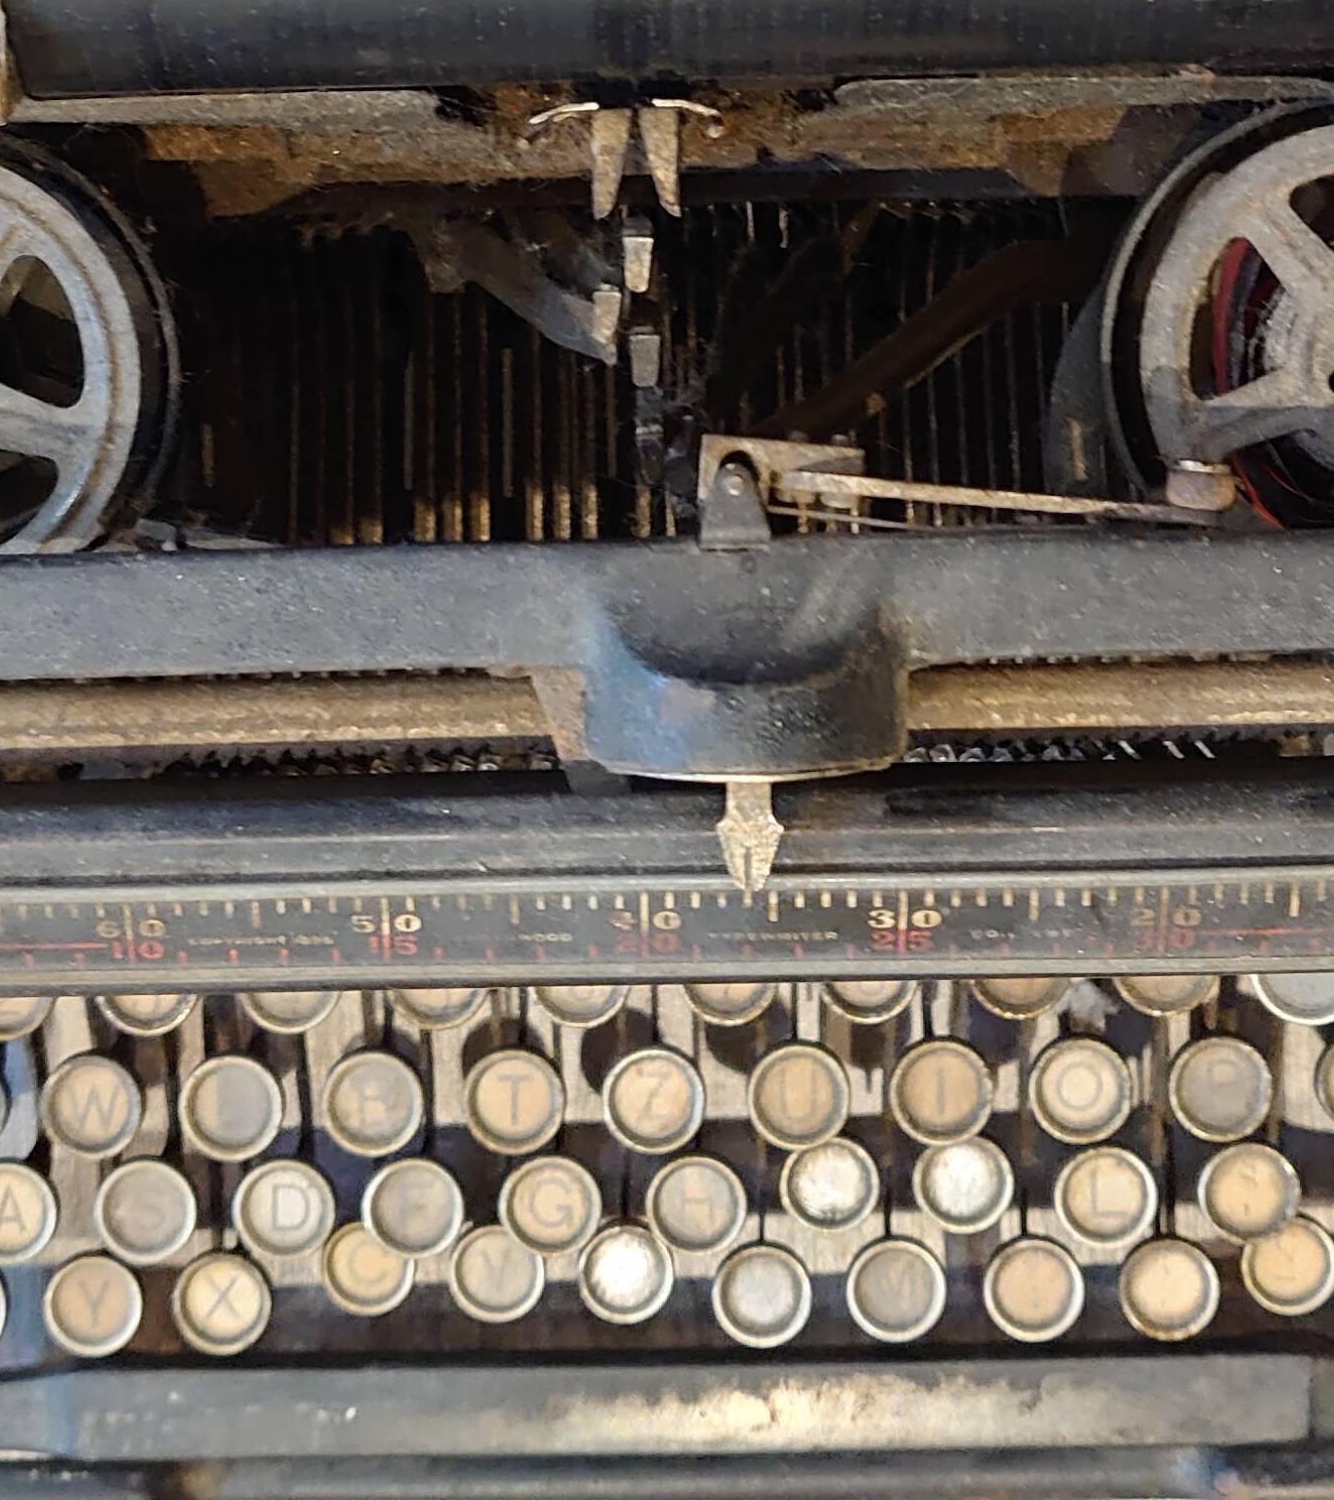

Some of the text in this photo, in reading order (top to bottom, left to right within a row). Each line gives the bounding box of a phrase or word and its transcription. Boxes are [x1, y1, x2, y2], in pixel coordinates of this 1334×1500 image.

[350, 914, 423, 934] 50
[868, 908, 944, 930] 30
[869, 929, 934, 951] 25
[68, 1082, 121, 1131] W
[496, 1071, 534, 1126] T
[635, 1068, 671, 1123] Z
[778, 1066, 819, 1122] U
[270, 1182, 311, 1232] D
[529, 1176, 575, 1228] G
[682, 1177, 717, 1228] H
[1091, 1168, 1131, 1220] L
[346, 1240, 391, 1285] C
[77, 1280, 110, 1329] Y
[206, 1277, 240, 1320] X
